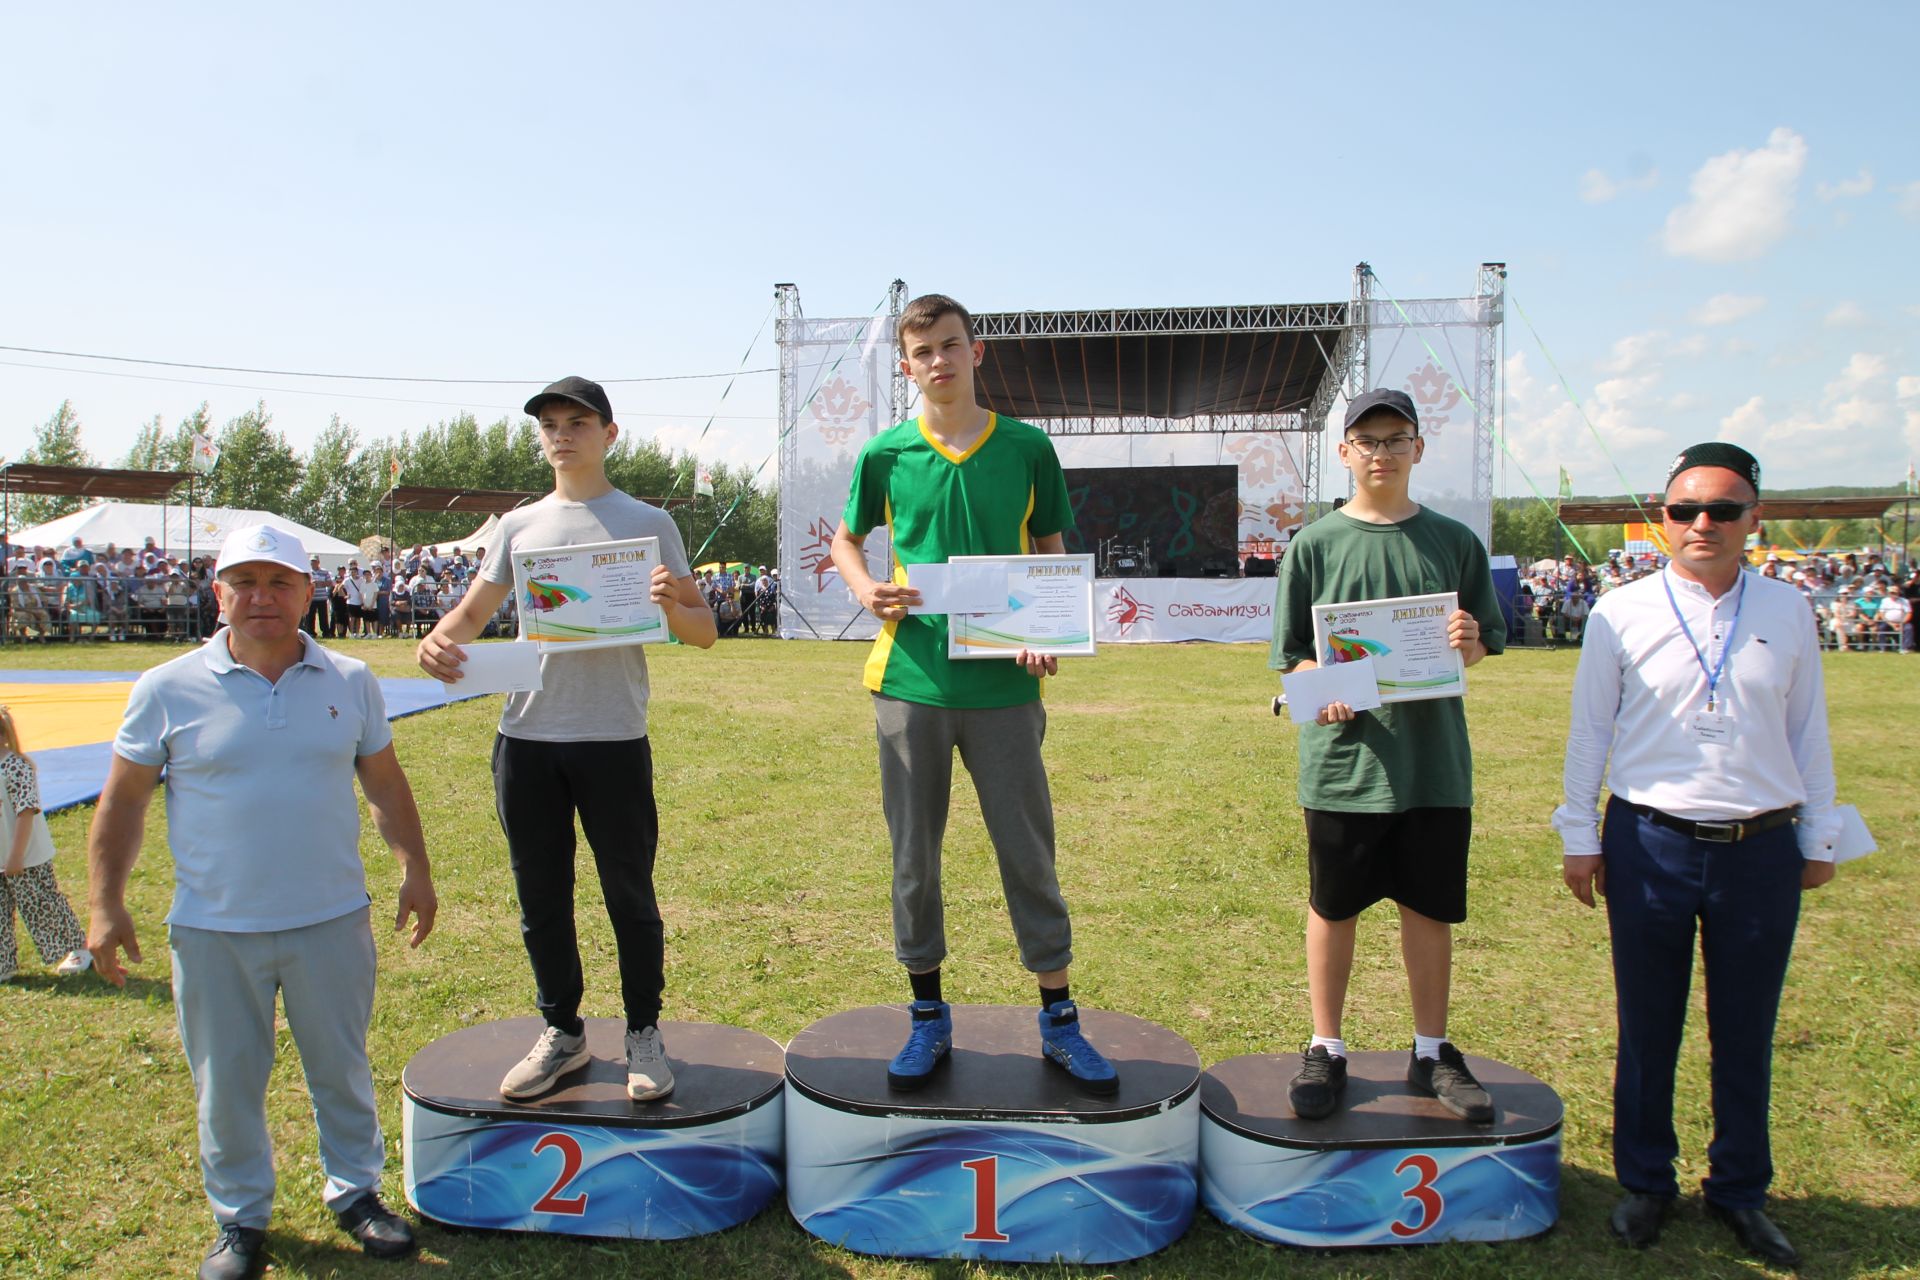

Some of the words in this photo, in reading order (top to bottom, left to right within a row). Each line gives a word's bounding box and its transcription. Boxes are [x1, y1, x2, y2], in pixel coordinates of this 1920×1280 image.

[592, 550, 646, 568] ДИПЛОМ
[1027, 565, 1082, 579] ДИПЛОМ
[1168, 603, 1271, 619] Сабантуй
[1392, 605, 1446, 623] ДИПЛОМ
[531, 1132, 588, 1216] 2
[960, 1154, 1010, 1245] 1
[1390, 1153, 1444, 1238] 3
